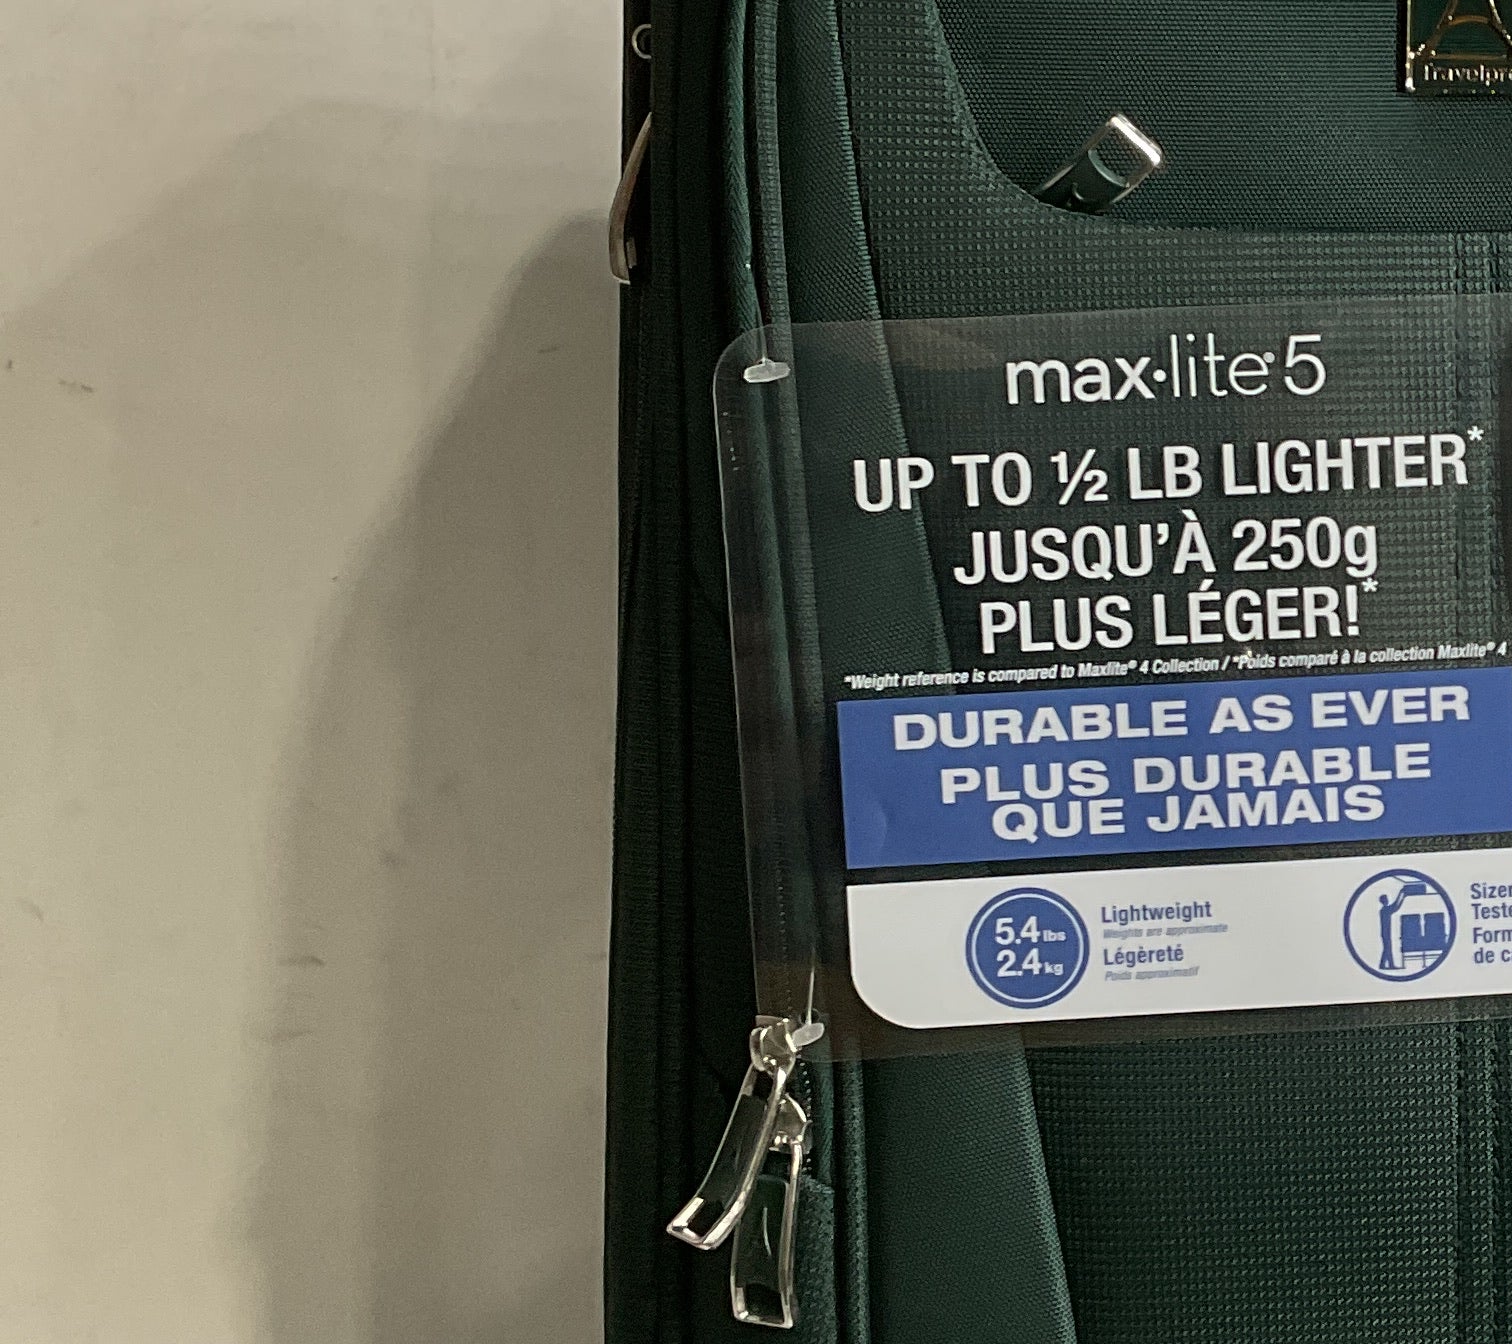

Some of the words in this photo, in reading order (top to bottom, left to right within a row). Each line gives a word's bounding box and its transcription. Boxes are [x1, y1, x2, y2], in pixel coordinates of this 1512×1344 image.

[853, 458, 935, 514] UP
[951, 454, 1032, 507] TO
[1129, 445, 1203, 500] LB
[1232, 518, 1378, 578] 250g
[981, 595, 1134, 654] PLUS
[901, 671, 969, 687] reference
[972, 669, 985, 682] is
[988, 664, 1058, 683] compared
[1061, 664, 1074, 678] to
[1139, 662, 1148, 674] 4
[1152, 657, 1219, 674] Collection
[1279, 650, 1338, 668] comparé
[1341, 649, 1350, 663] à
[1353, 650, 1366, 663] la
[1370, 646, 1435, 663] collection
[1497, 642, 1506, 655] 4
[894, 701, 1188, 750] DURABLE
[1210, 694, 1294, 734] AS
[1311, 685, 1470, 728] EVER
[941, 761, 1109, 804] PLUS
[1135, 743, 1430, 795] DURABLE
[992, 799, 1124, 843] QUE
[1147, 784, 1385, 831] JAMAIS
[995, 916, 1040, 945] 5.4
[1043, 930, 1066, 943] lbs
[1101, 901, 1212, 926] Lightweight
[996, 947, 1042, 977] 2.4
[1044, 962, 1063, 975] kg
[1104, 944, 1184, 967] Légèreté
[1474, 948, 1494, 963] de
